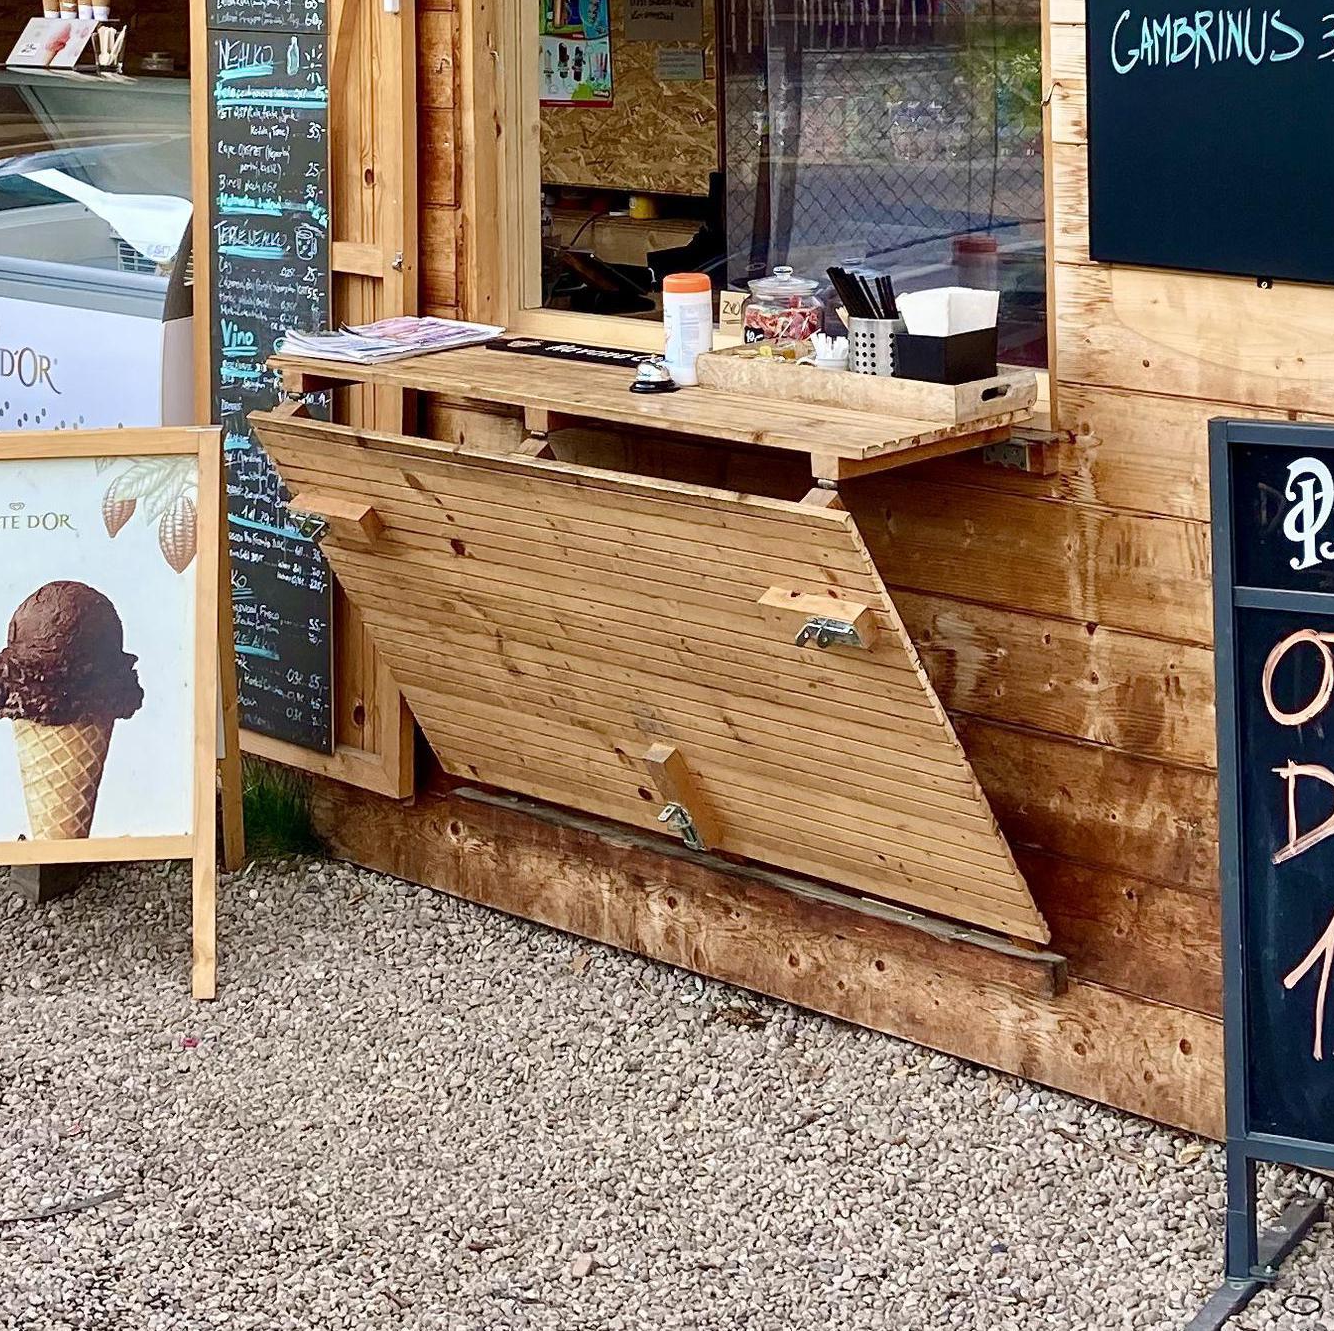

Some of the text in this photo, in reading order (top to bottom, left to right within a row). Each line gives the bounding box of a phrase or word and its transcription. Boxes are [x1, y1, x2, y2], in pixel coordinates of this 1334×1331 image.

[1111, 9, 1304, 74] GAMBRINUS
[0, 346, 62, 394] D'OR
[27, 511, 77, 532] D'OR
